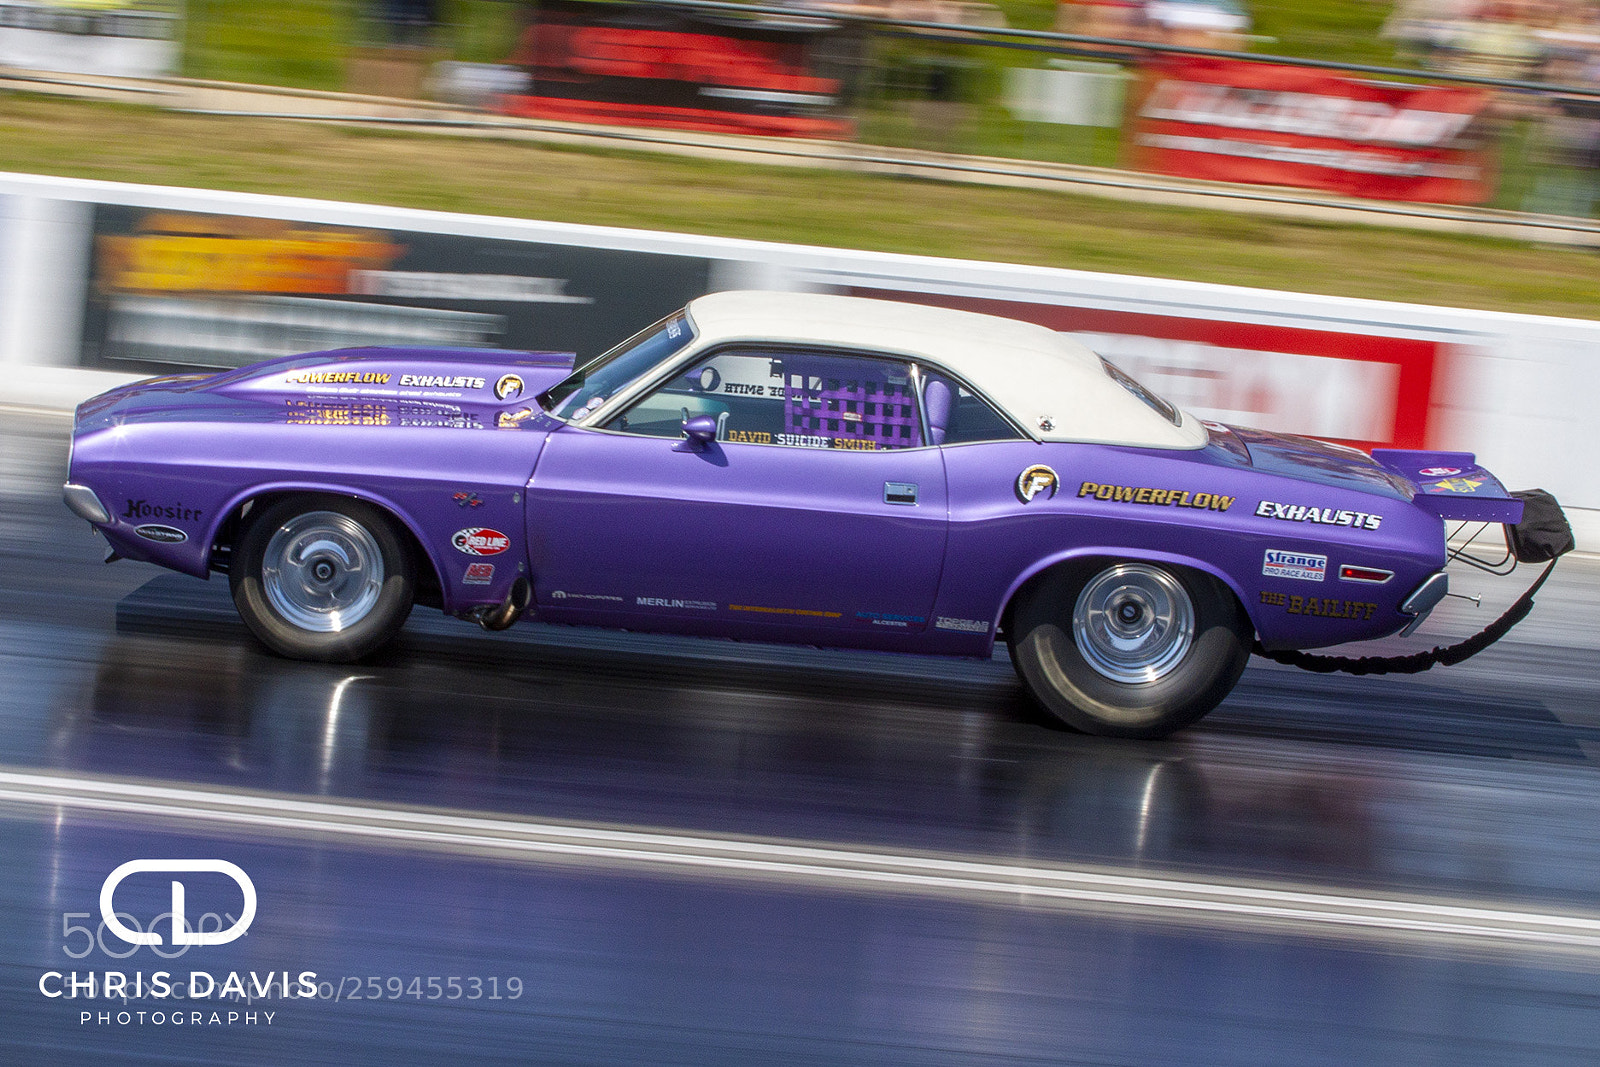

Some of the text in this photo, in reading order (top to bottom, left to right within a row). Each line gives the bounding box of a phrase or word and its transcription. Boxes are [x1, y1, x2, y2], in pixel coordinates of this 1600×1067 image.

[287, 371, 486, 389] POWERFLOW EXHAUSTS
[728, 430, 771, 444] DAVID
[834, 438, 876, 451] SMITH
[122, 499, 203, 521] Hoosier
[1078, 481, 1383, 531] POWERFLOW EXHAUSTS
[487, 536, 507, 548] LINE
[1266, 551, 1326, 569] Strange
[1264, 566, 1325, 581] PRO RACE AXLES
[636, 596, 685, 608] MERLIN
[1260, 590, 1378, 620] THE BAILIFF
[872, 619, 908, 627] ALCESTER
